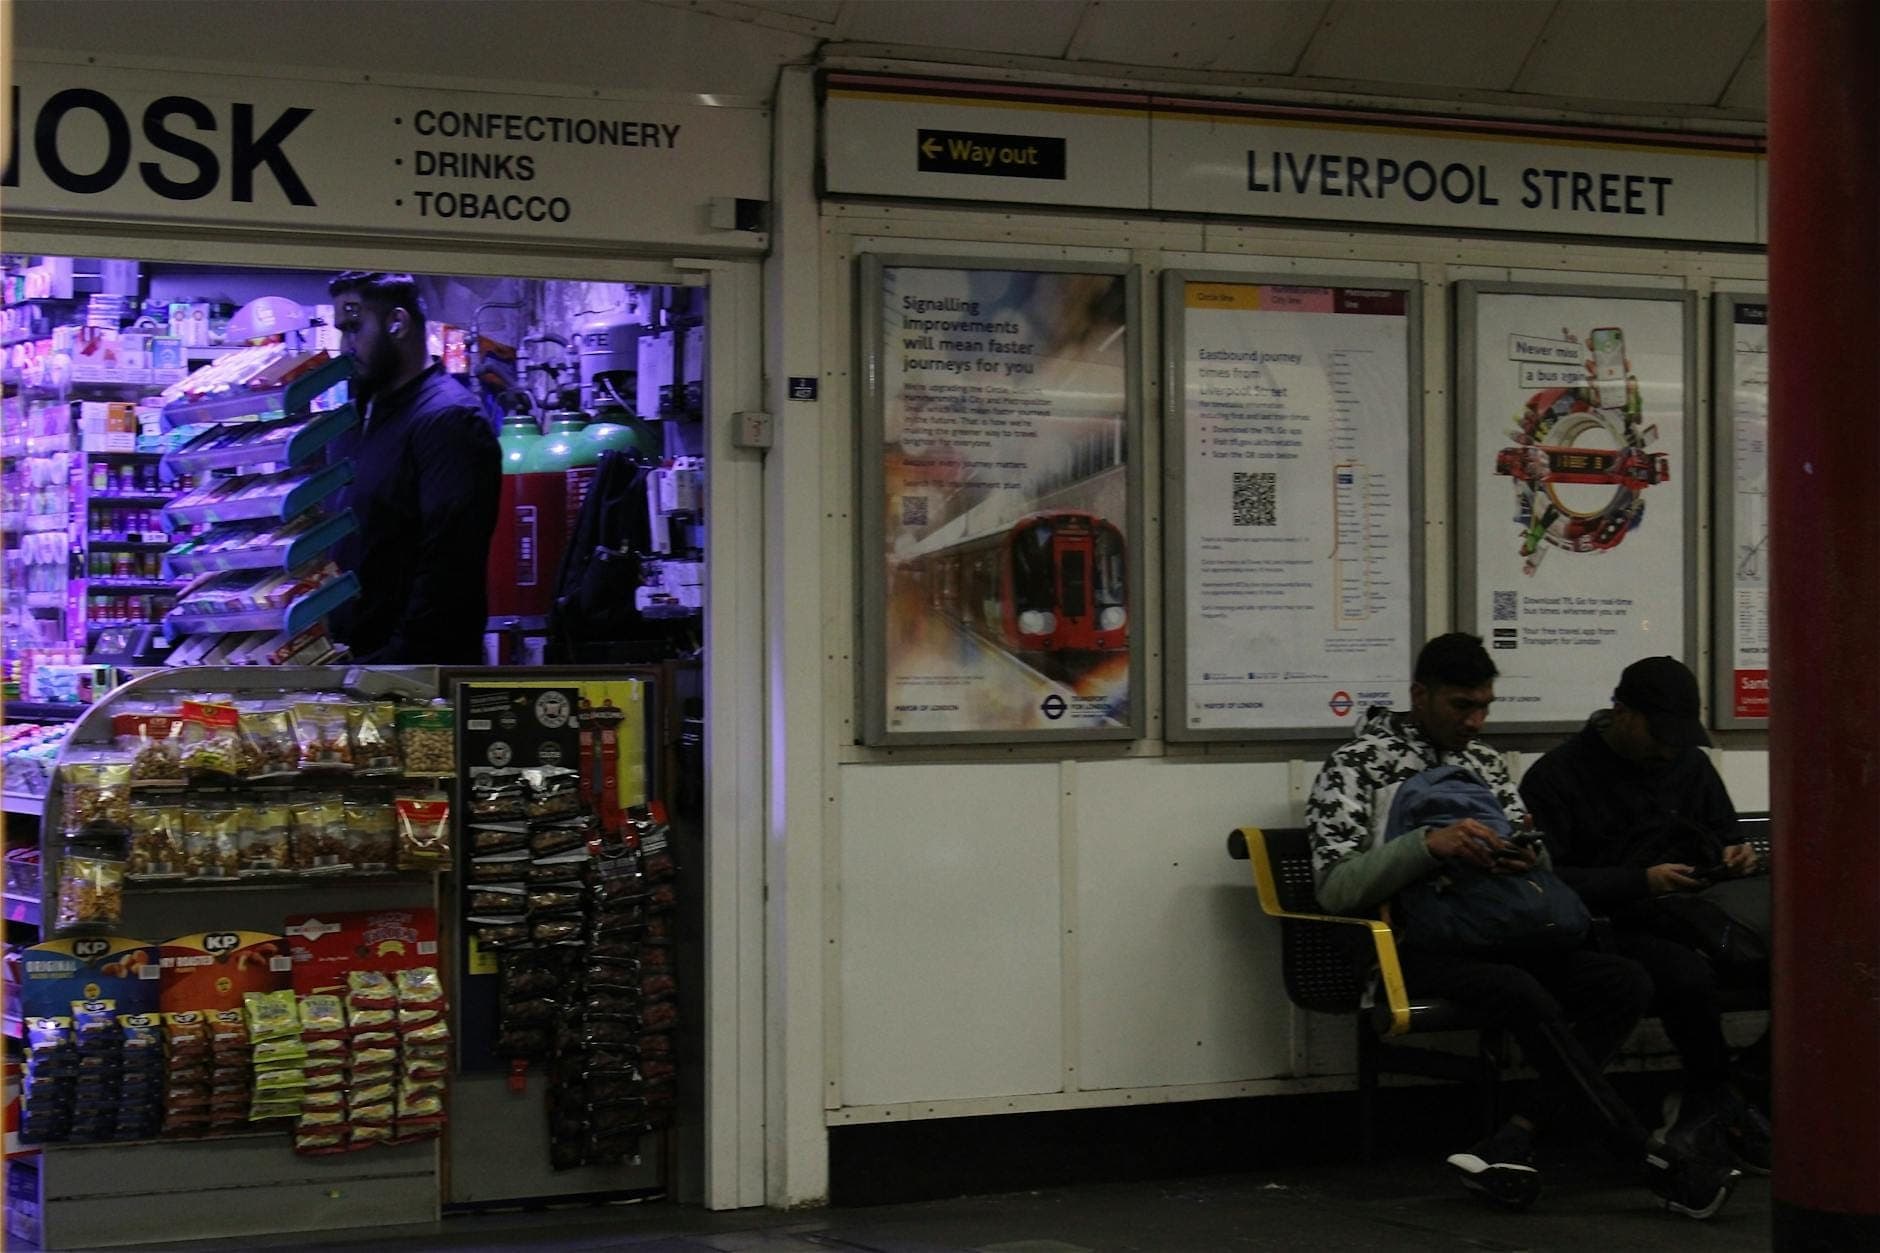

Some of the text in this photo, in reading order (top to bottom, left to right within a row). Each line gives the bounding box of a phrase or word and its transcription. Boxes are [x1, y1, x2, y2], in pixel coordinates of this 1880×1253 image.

[413, 109, 682, 150] CONFECTIONERY
[947, 137, 1040, 167] Way out
[413, 151, 535, 181] DRINKS
[1247, 150, 1673, 216] LIVERPOOL STREET
[413, 192, 571, 222] TOBACCO
[903, 296, 981, 316] Signalling
[903, 316, 1019, 334] improvements
[903, 336, 1035, 355] will mean faster
[1516, 341, 1578, 358] Never miss
[903, 356, 1034, 377] journeys for you
[1199, 349, 1302, 365] Eastbound journey
[1526, 372, 1533, 381] a
[1537, 369, 1557, 381] bus
[77, 941, 108, 956] KP
[206, 935, 238, 951] KP
